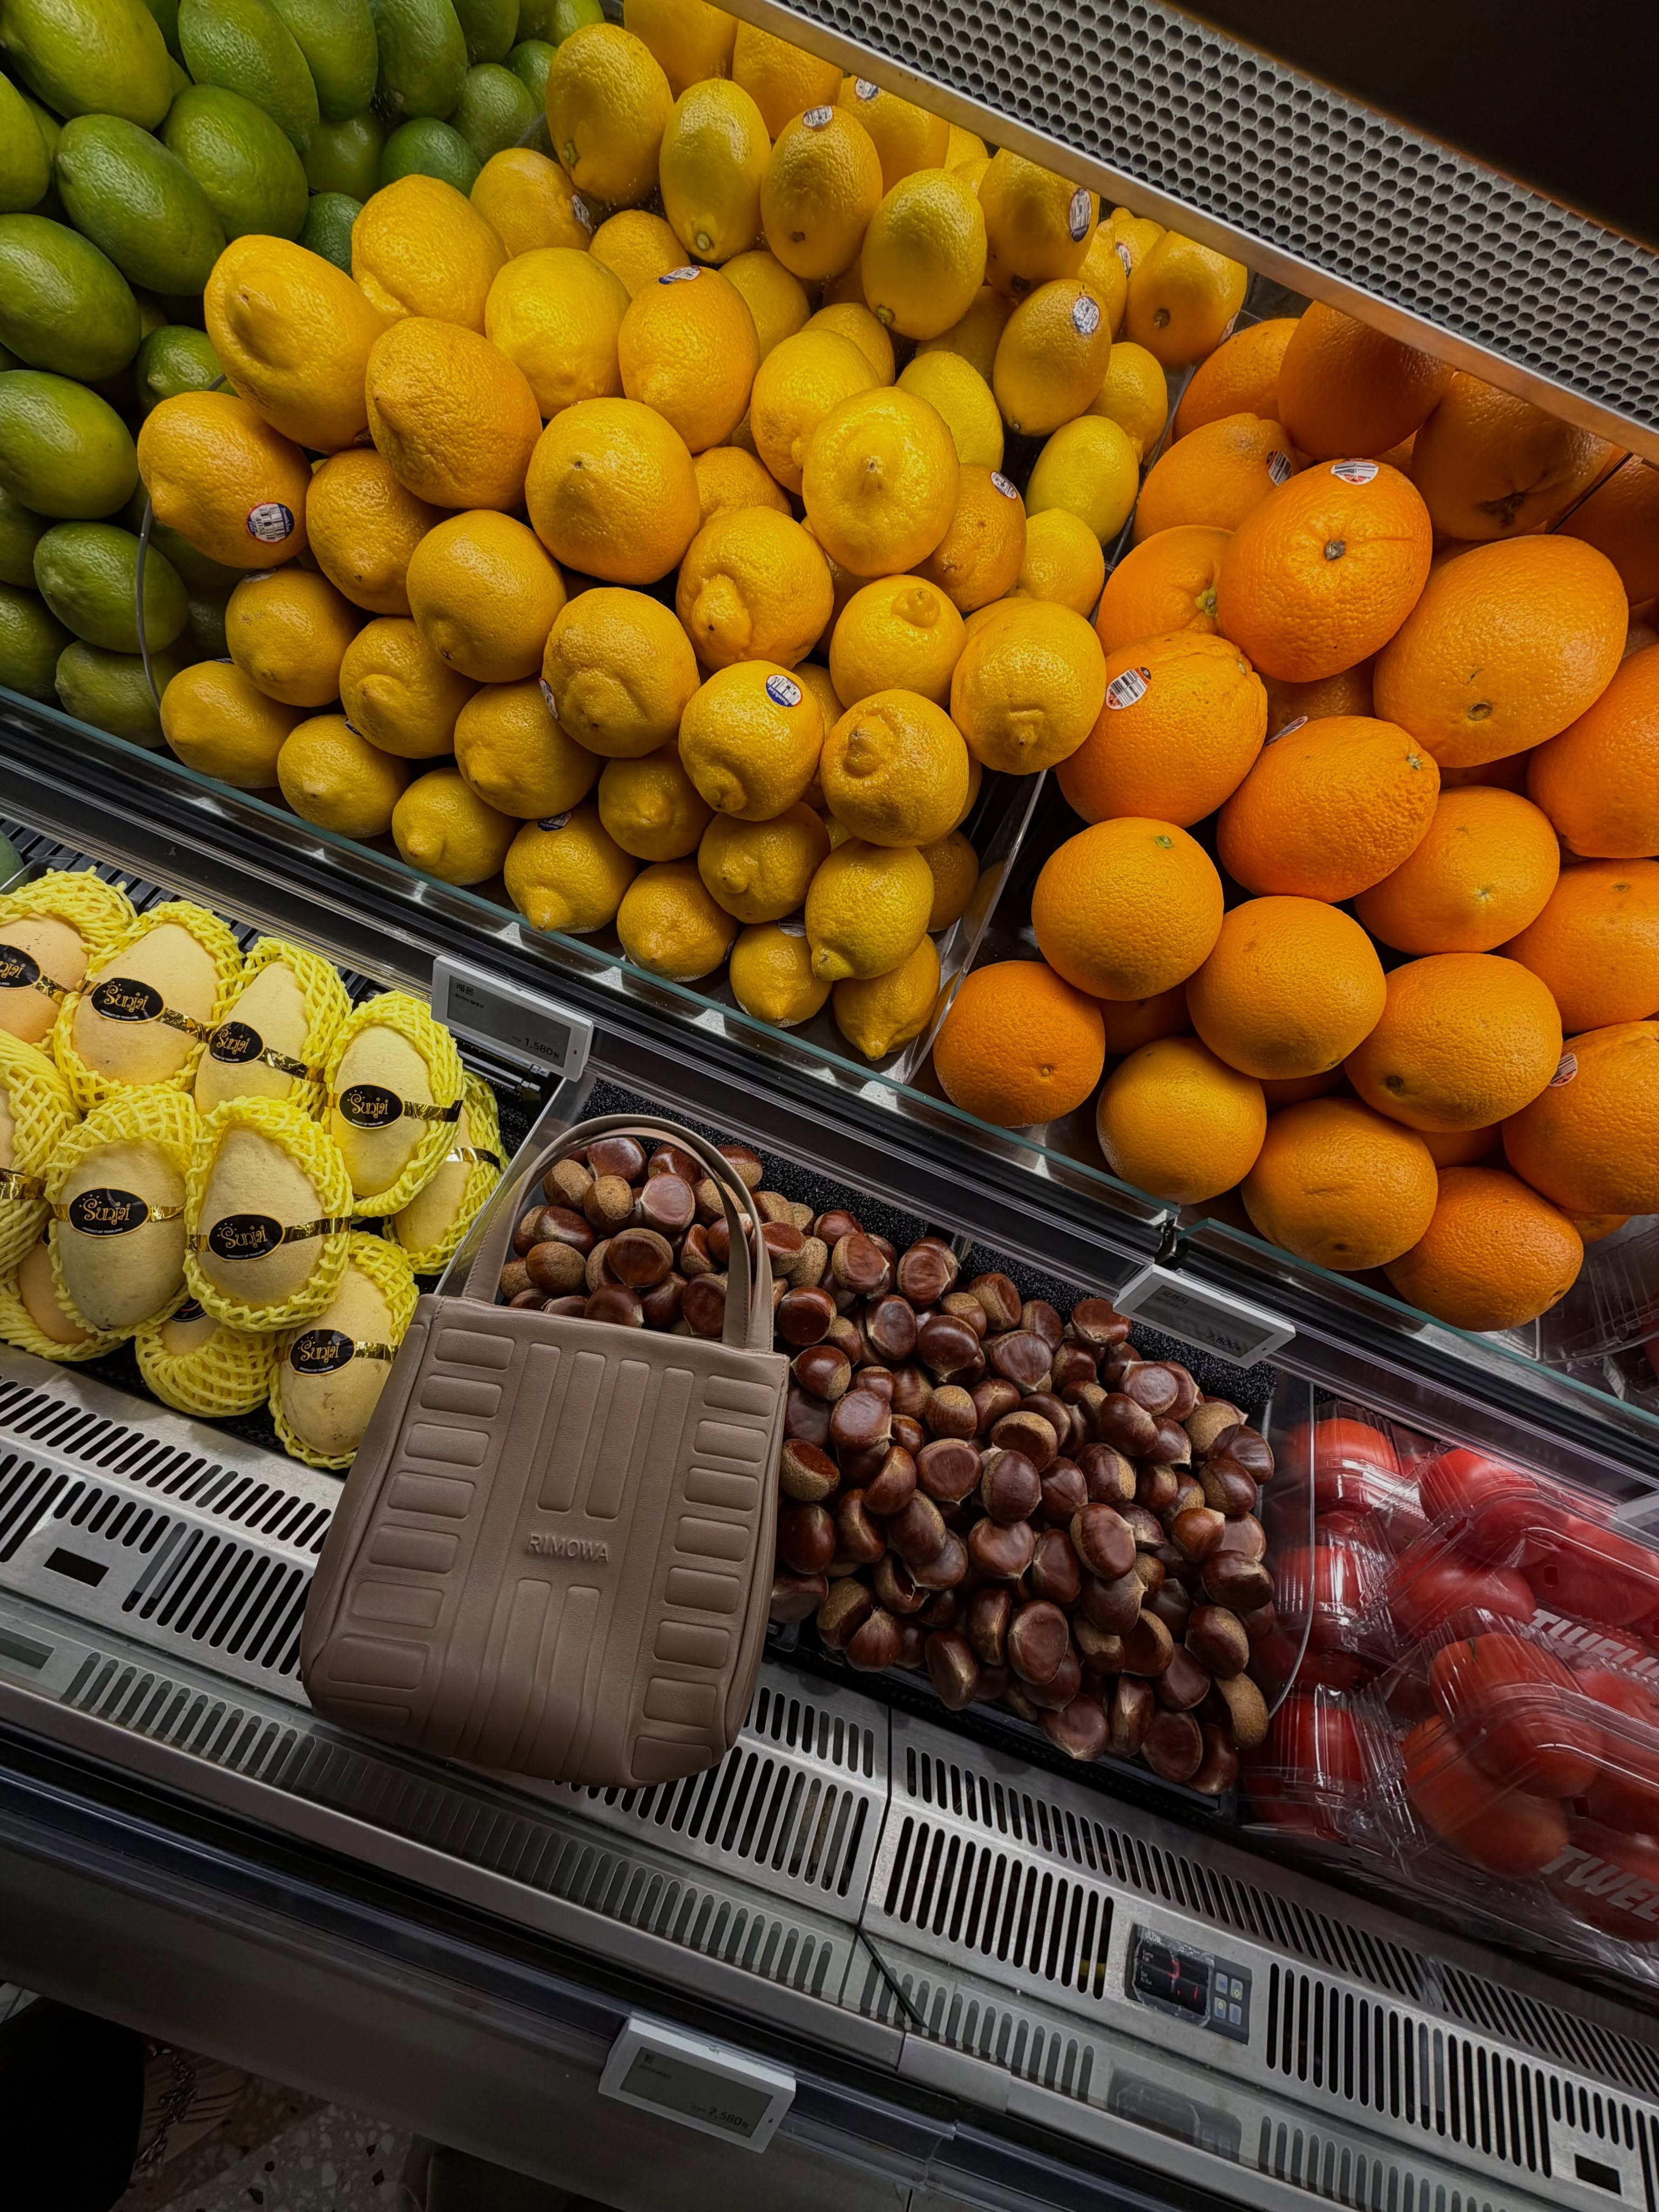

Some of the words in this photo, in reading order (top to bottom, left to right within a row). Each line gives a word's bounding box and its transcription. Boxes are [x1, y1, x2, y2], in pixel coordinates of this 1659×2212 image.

[255, 516, 266, 535] 4053
[0, 959, 26, 979] njai
[103, 984, 149, 1013] Sunjai
[216, 1029, 251, 1055] Sunjai
[350, 1094, 389, 1119] Sunjai
[83, 1198, 131, 1225] Sunjai
[220, 1225, 268, 1249] Sunjai
[300, 1339, 340, 1364] Sunjai
[527, 1533, 609, 1562] RIMOWA
